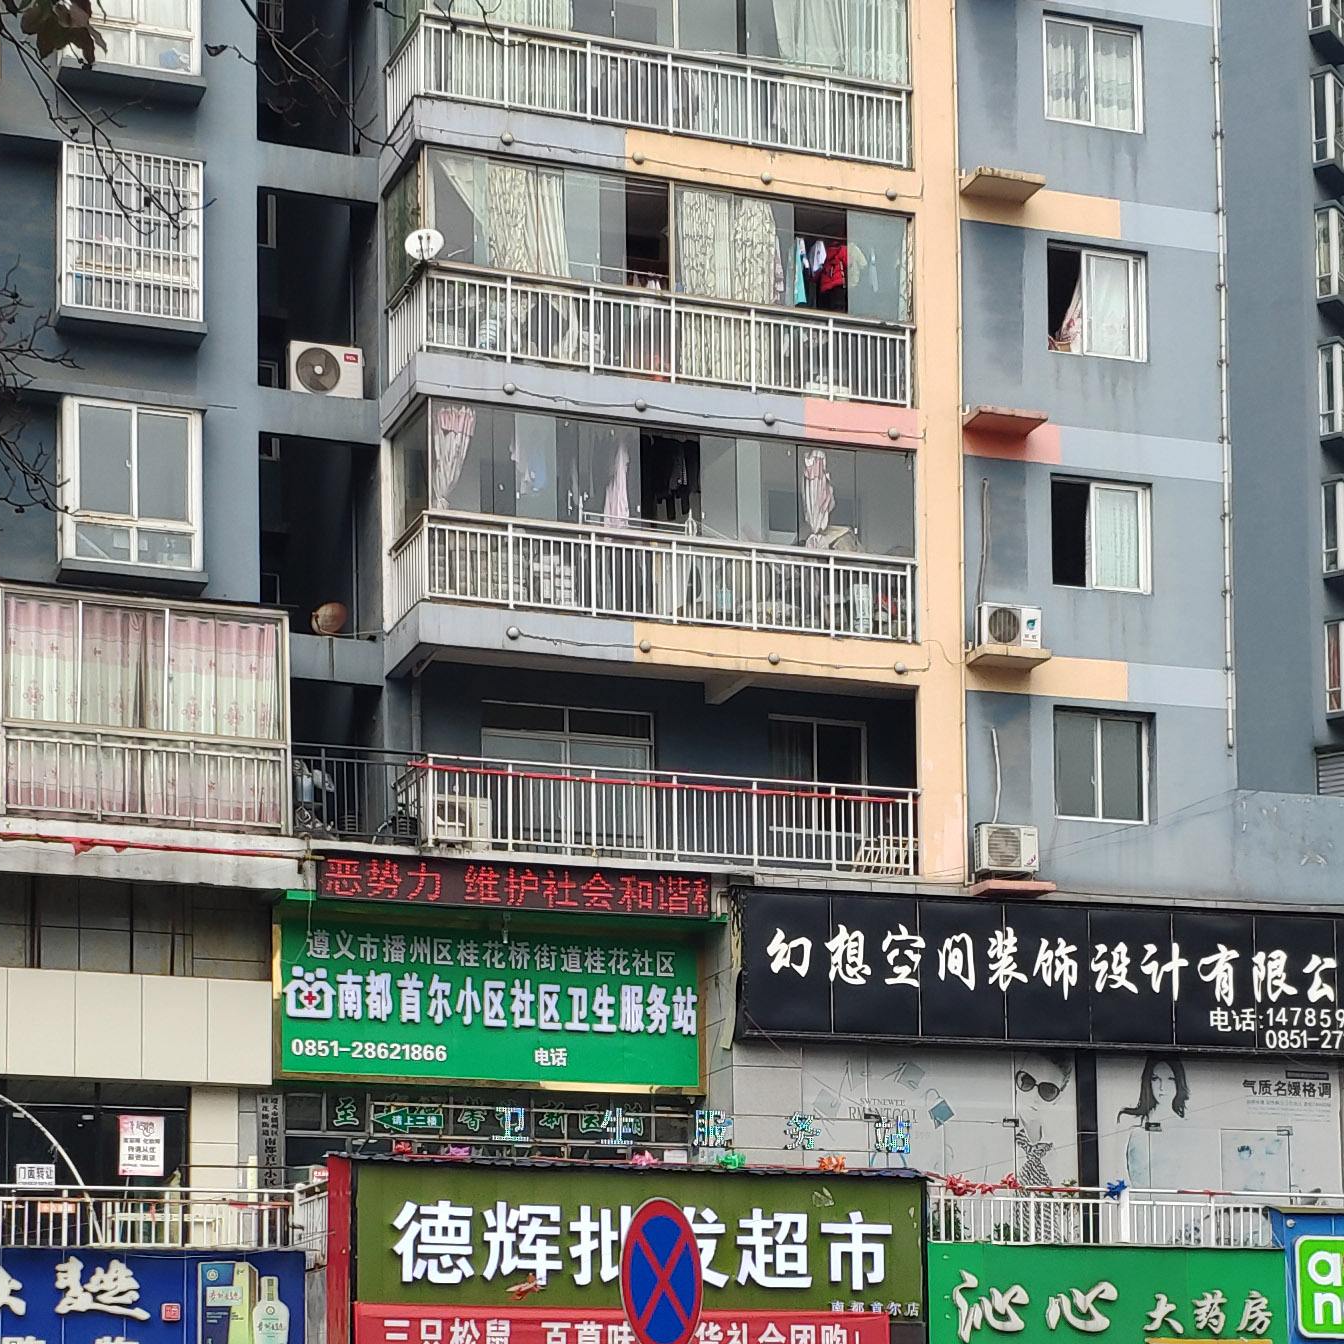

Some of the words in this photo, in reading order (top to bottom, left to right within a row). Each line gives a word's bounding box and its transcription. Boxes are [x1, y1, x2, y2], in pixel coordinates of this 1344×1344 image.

[324, 856, 443, 901] 恶势力
[306, 929, 676, 977] 遵义市播州区桂花桥街道桂花社区
[338, 970, 698, 1036] 南都首尔小区社区卫生服务站
[291, 1039, 447, 1062] 0851-28621866
[534, 1047, 568, 1067] 电话
[1243, 1080, 1332, 1098] 气质名媛格调
[392, 1115, 437, 1127] 请上二楼
[18, 1167, 54, 1180] 门面转让
[392, 1200, 893, 1291] 德辉批发超市
[954, 1269, 1119, 1344] 沁心
[1143, 1290, 1273, 1335] 大药房
